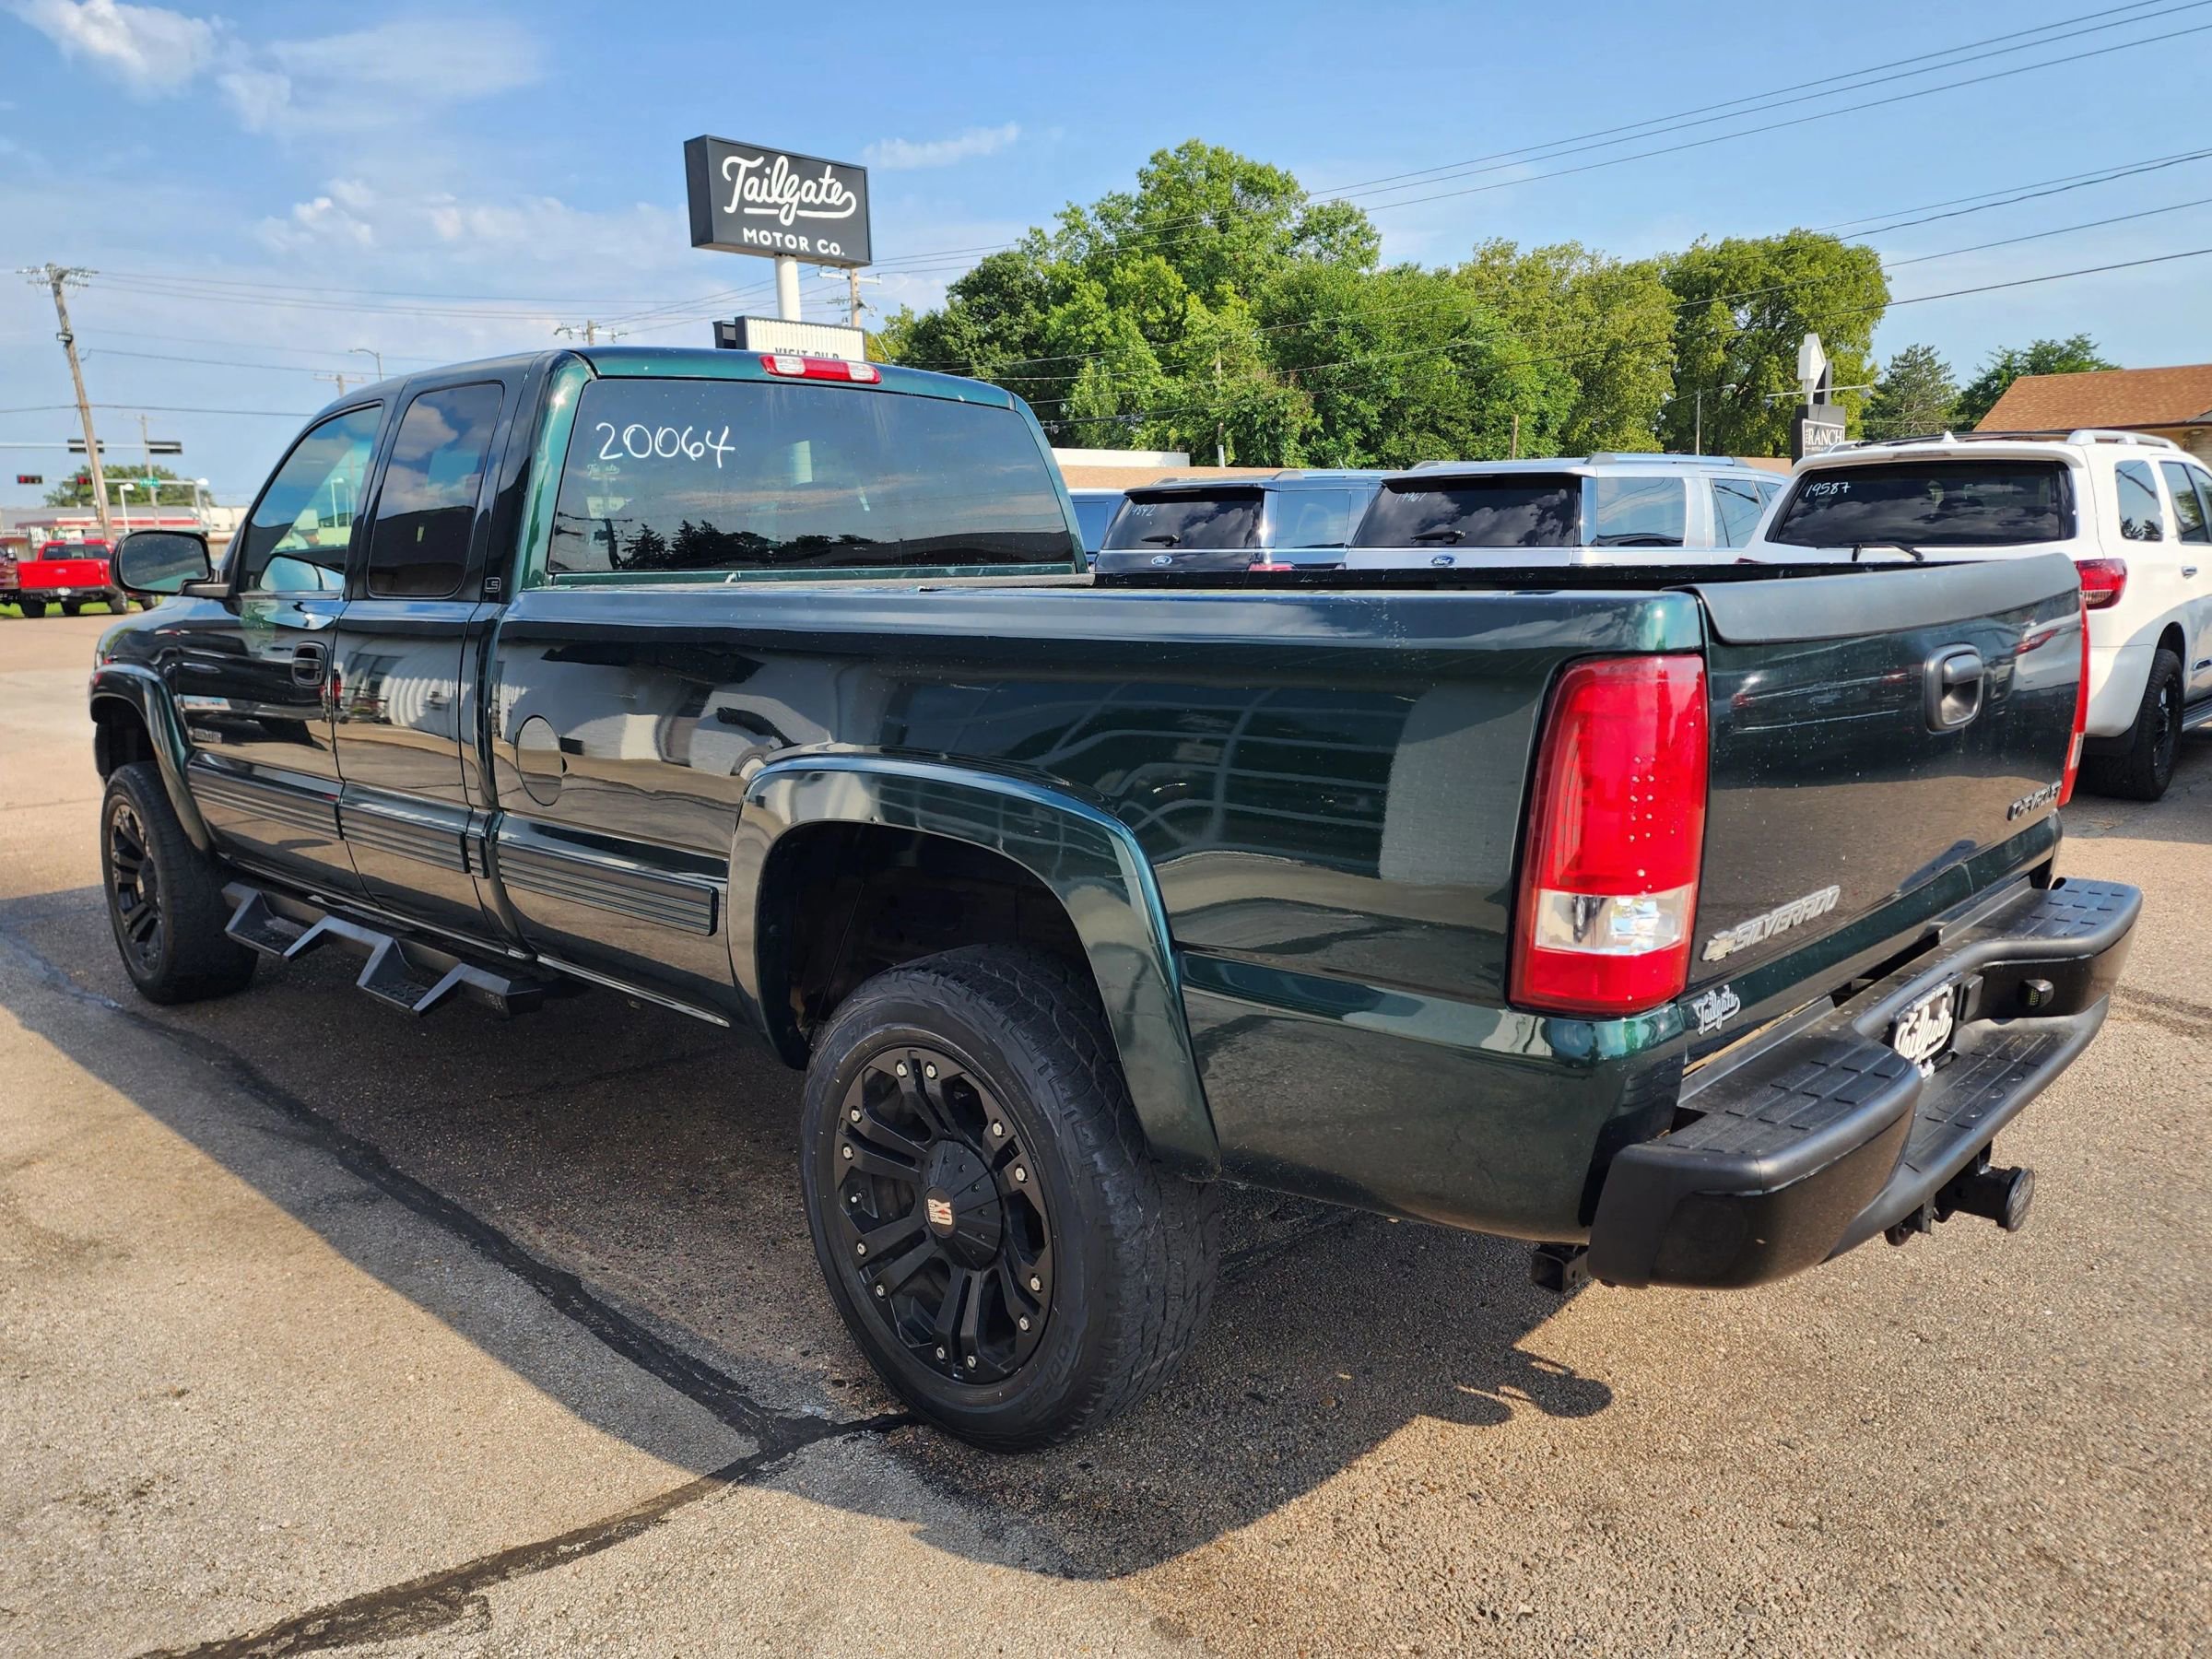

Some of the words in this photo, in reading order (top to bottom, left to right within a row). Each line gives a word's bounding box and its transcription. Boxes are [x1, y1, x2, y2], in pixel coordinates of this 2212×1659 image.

[723, 155, 857, 227] Tailgate
[743, 228, 810, 253] MOTOR
[817, 239, 845, 256] CO.
[595, 422, 735, 469] 20064
[1808, 428, 1843, 446] RANCH
[1805, 481, 1852, 498] 19587
[1733, 885, 1841, 952] SILVERADO
[1692, 984, 1741, 1036] Tailgate
